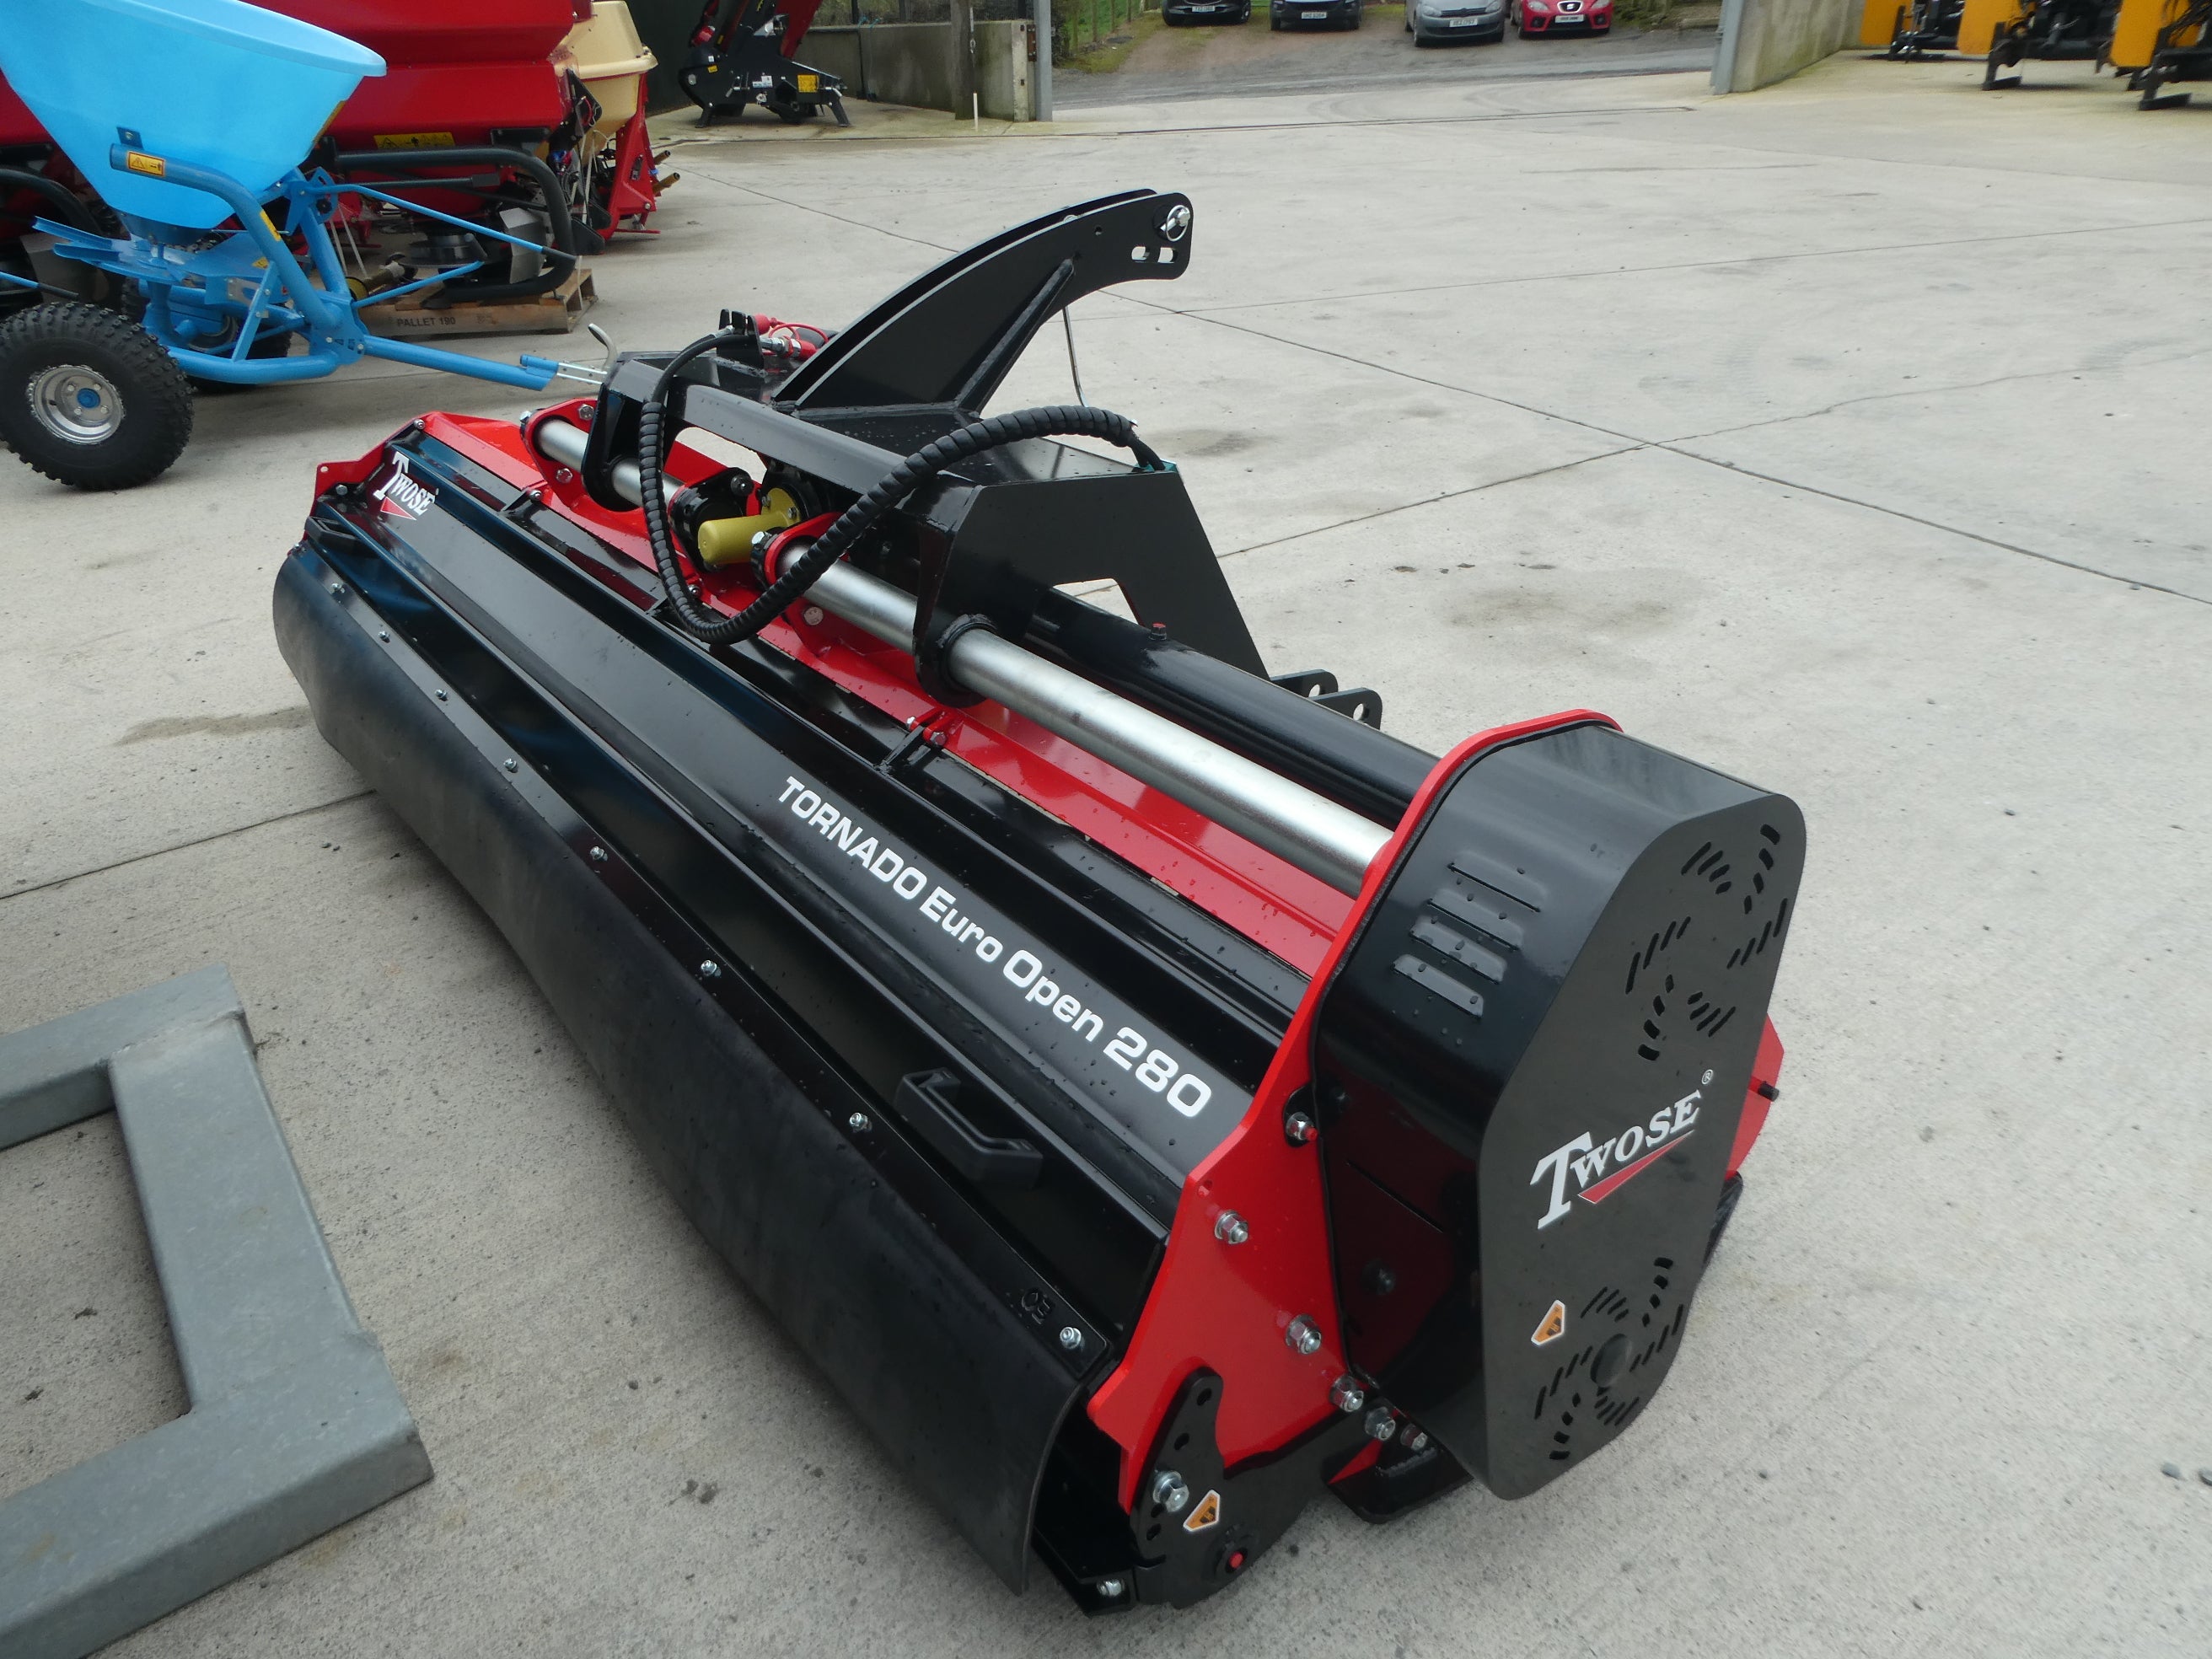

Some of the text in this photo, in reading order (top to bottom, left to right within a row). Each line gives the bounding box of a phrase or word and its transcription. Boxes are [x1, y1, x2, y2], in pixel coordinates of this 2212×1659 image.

[396, 317, 437, 327] PALLET
[778, 776, 1212, 1118] TORNADO Euro Open 280
